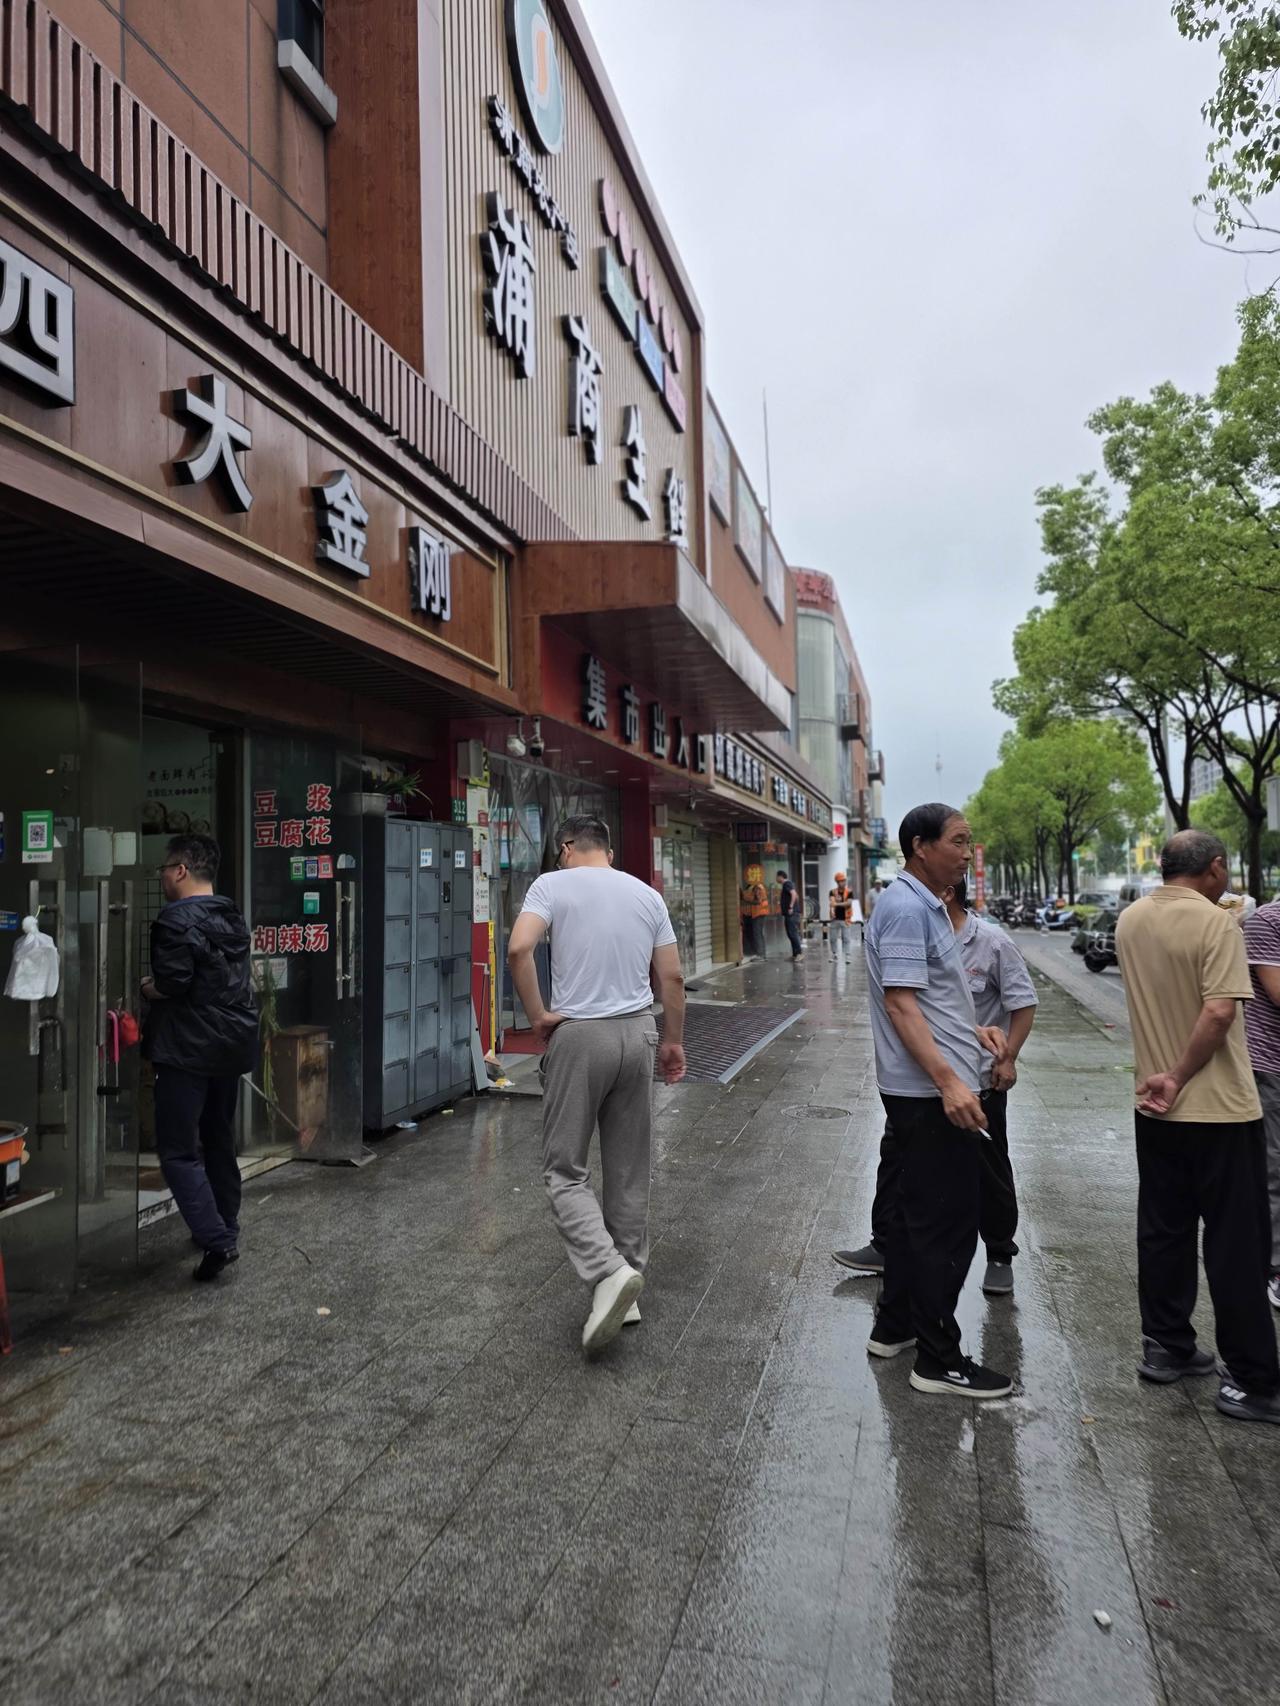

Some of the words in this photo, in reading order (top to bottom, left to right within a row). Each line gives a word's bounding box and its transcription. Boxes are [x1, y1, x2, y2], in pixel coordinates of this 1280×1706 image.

[0, 238, 452, 622] 四大金刚
[584, 654, 710, 774] 集市出入口
[254, 783, 332, 817] 豆浆
[254, 816, 332, 848] 豆腐花
[253, 923, 329, 954] 胡辣汤
